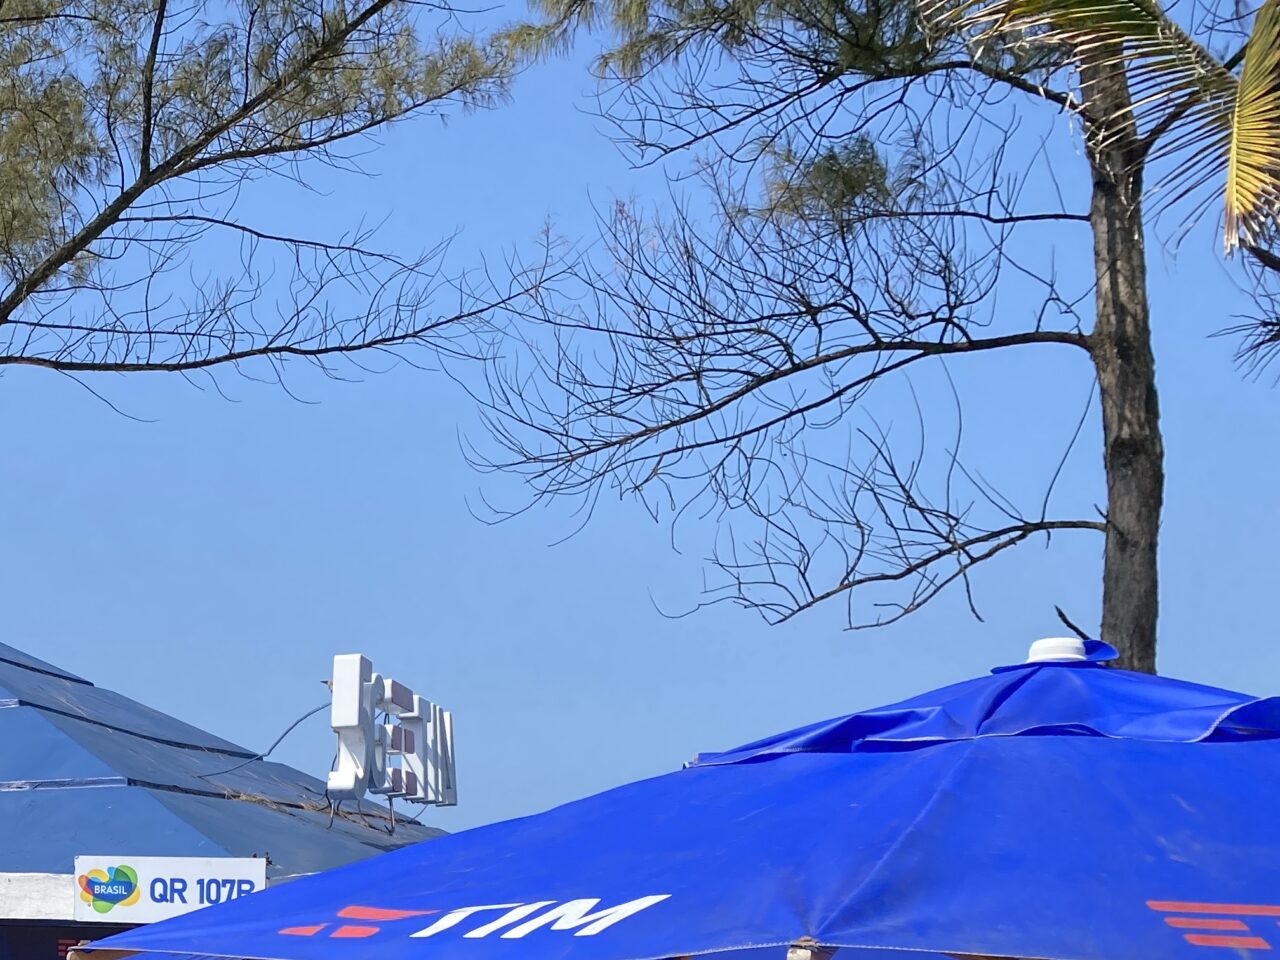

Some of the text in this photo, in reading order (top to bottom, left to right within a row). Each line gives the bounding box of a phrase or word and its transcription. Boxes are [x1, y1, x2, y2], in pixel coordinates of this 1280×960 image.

[93, 884, 128, 896] BRASIL
[149, 876, 188, 904] QR
[409, 893, 673, 939] TIM
